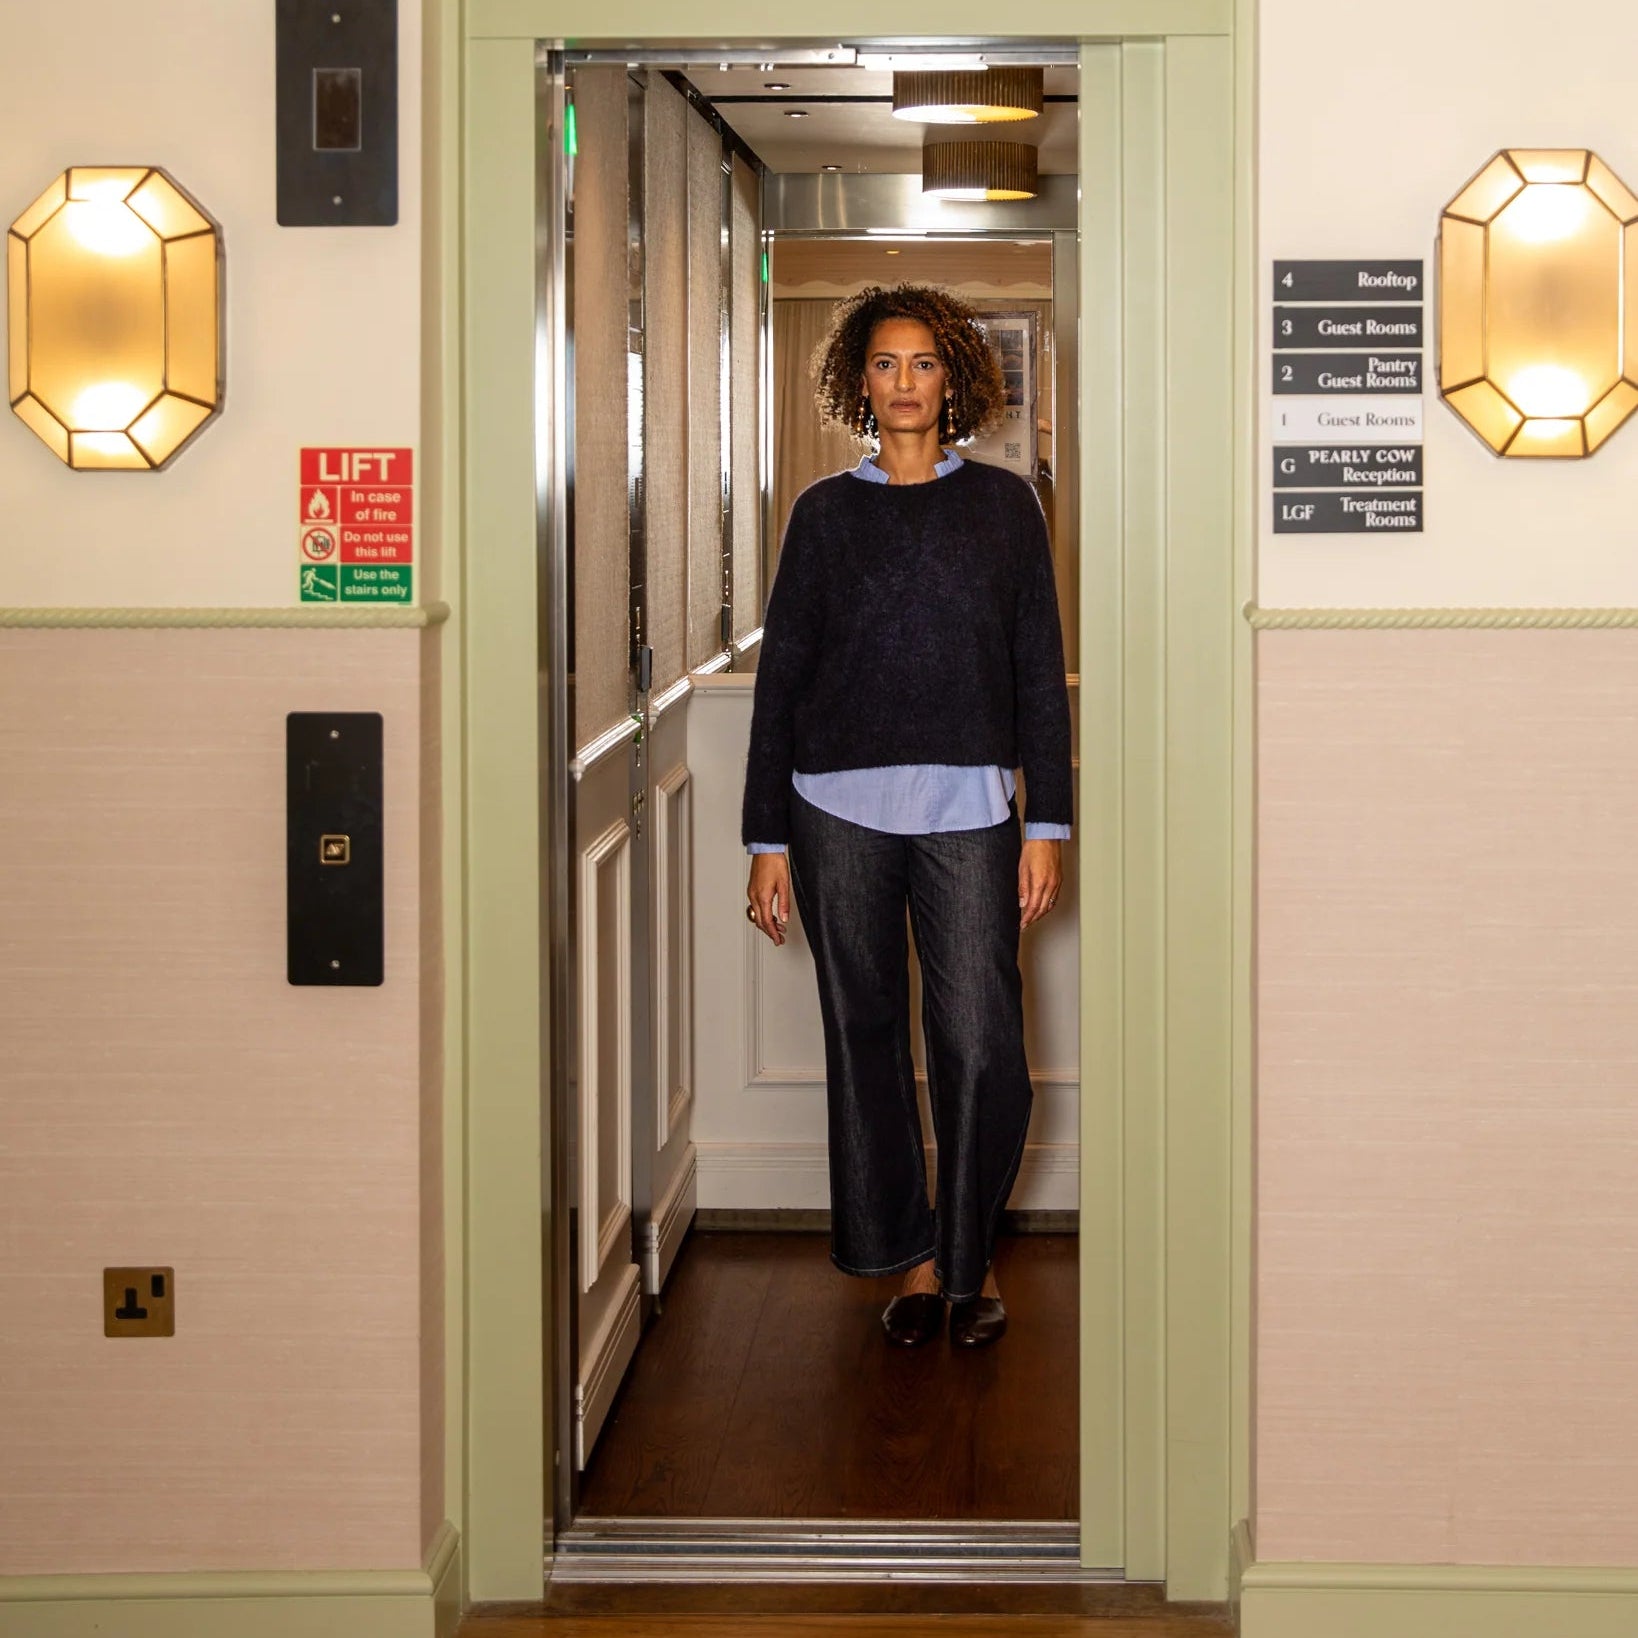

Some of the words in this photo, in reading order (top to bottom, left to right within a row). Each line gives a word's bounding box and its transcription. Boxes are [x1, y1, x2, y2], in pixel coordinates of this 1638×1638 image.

[1282, 272, 1293, 288] 4
[1357, 271, 1417, 291] Rooftop
[1282, 320, 1293, 335] 3
[1318, 320, 1362, 335] Guest
[1366, 320, 1417, 335] Rooms
[1282, 365, 1293, 381] 2
[1368, 357, 1417, 375] Pantry
[1318, 373, 1362, 388] Guest
[1366, 373, 1417, 388] Rooms
[1317, 413, 1361, 427] Guest
[1366, 413, 1416, 427] Rooms
[1308, 450, 1371, 464] PEARLY
[1376, 449, 1416, 464] COW
[319, 452, 396, 482] LIFT
[1281, 459, 1296, 474] G
[1343, 467, 1416, 485] Reception
[351, 490, 364, 503] In
[368, 492, 401, 503] case
[1282, 505, 1315, 520] LGF
[1340, 497, 1416, 513] Treatment
[355, 509, 371, 521] of
[373, 509, 397, 521] fire
[1366, 512, 1416, 528] Rooms
[344, 531, 361, 543] Do
[363, 532, 384, 543] not
[386, 533, 409, 543] use
[355, 546, 378, 557] this
[381, 546, 397, 557] lift
[353, 569, 377, 580] Use
[379, 569, 400, 580] the
[345, 584, 378, 596] stairs
[381, 584, 408, 597] only
